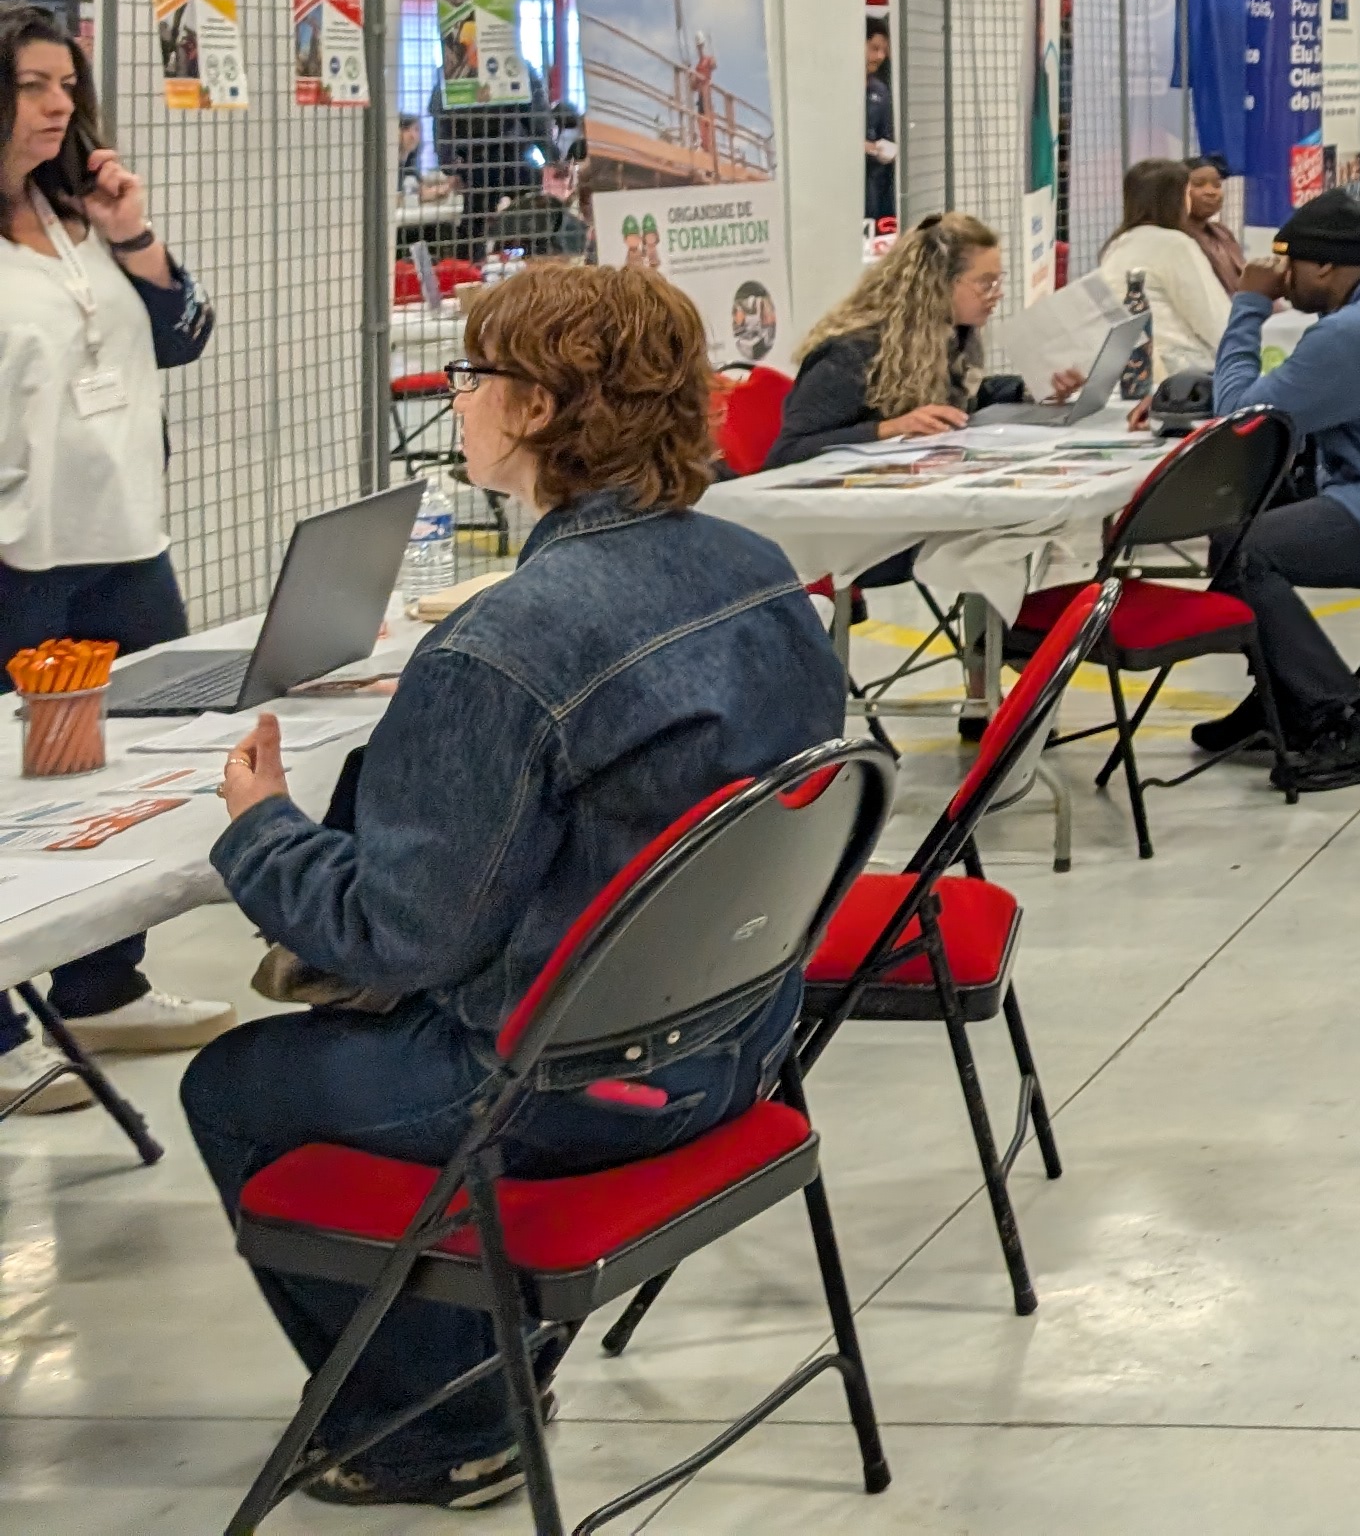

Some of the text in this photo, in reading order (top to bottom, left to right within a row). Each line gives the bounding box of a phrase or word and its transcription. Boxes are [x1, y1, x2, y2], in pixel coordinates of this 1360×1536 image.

[668, 201, 753, 224] ORGANISME DE
[668, 219, 770, 252] FORMATION
